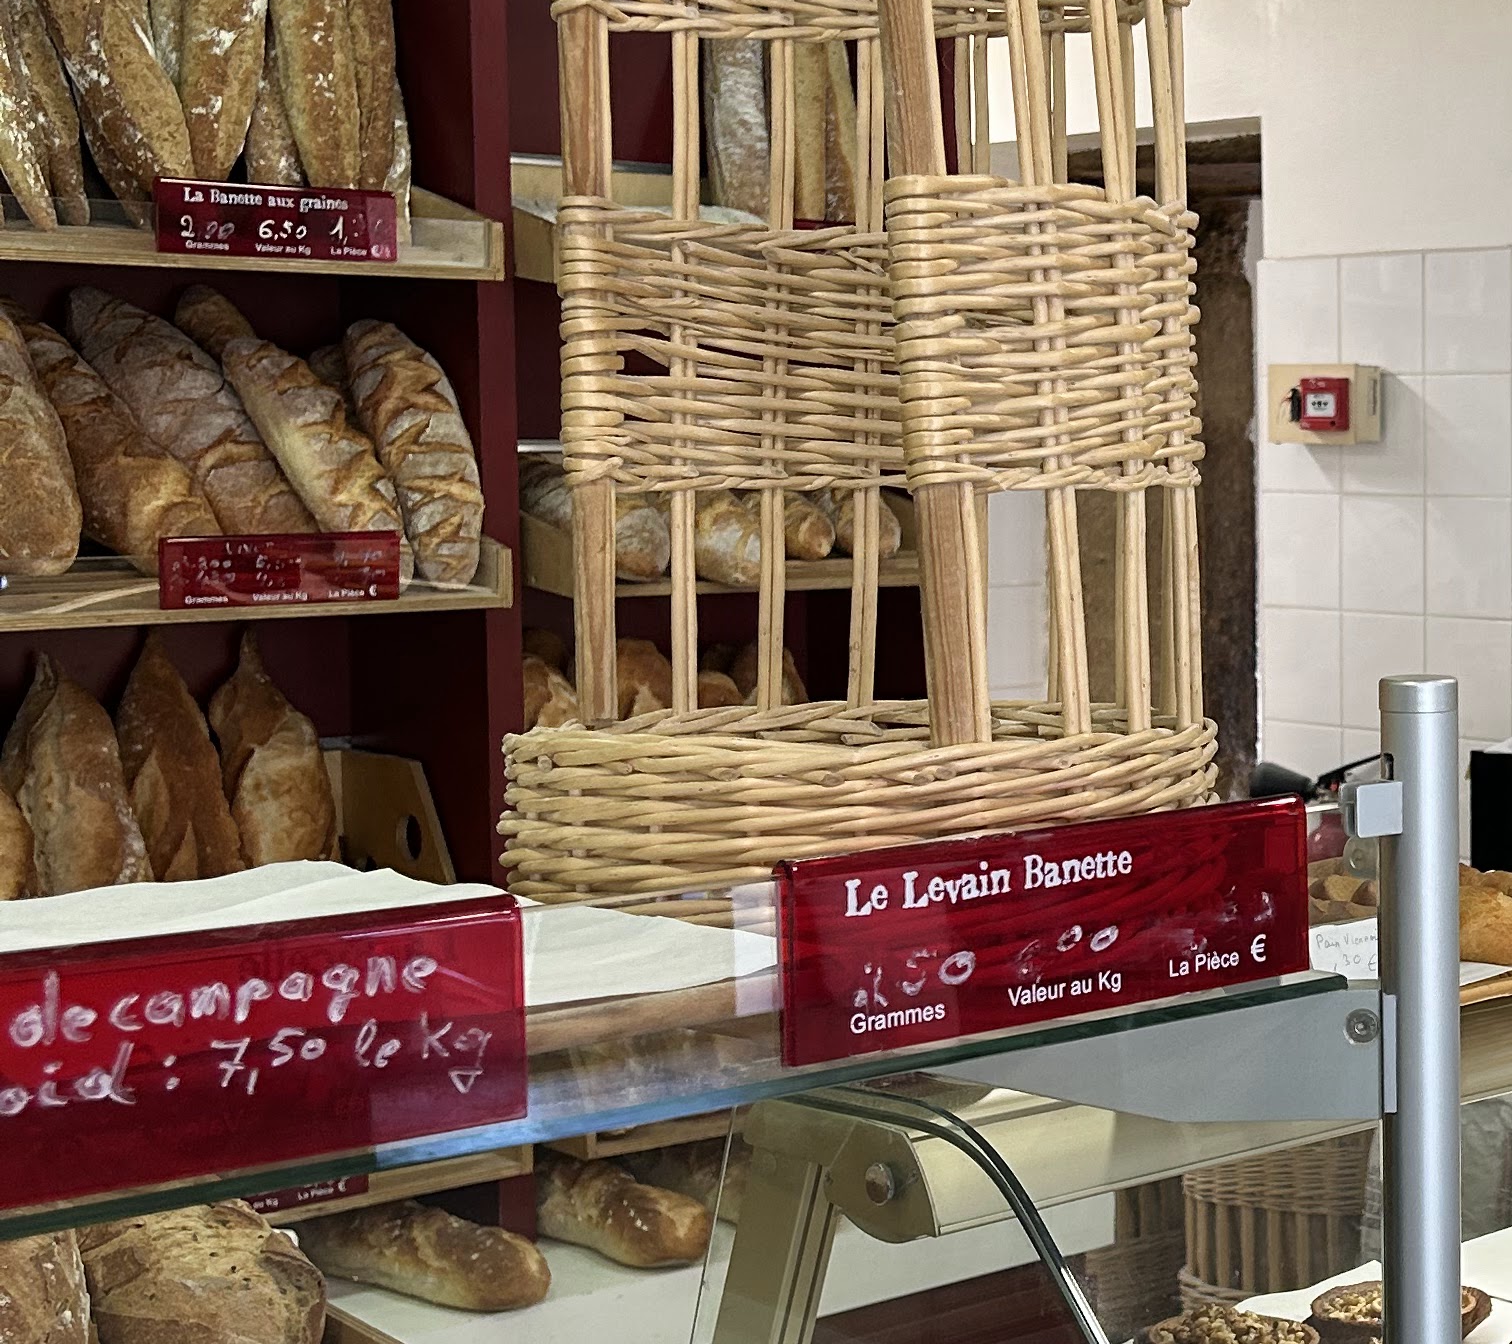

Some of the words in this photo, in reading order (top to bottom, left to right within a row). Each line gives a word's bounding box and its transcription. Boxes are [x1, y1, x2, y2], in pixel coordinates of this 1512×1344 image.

[183, 186, 205, 203] La
[210, 188, 263, 207] Banette
[267, 195, 295, 209] aux
[299, 196, 349, 214] graines
[258, 219, 308, 242] 6,50
[844, 877, 889, 918] Le
[901, 867, 1012, 910] Levain
[1023, 849, 1134, 891] Banette
[1168, 958, 1191, 979] La
[1194, 949, 1240, 974] Pièce
[1249, 933, 1268, 964] €
[1007, 981, 1067, 1007] Valeur
[1069, 976, 1093, 997] au
[1098, 969, 1122, 993] Kg
[849, 1002, 947, 1035] Grammes
[354, 1017, 402, 1069] le
